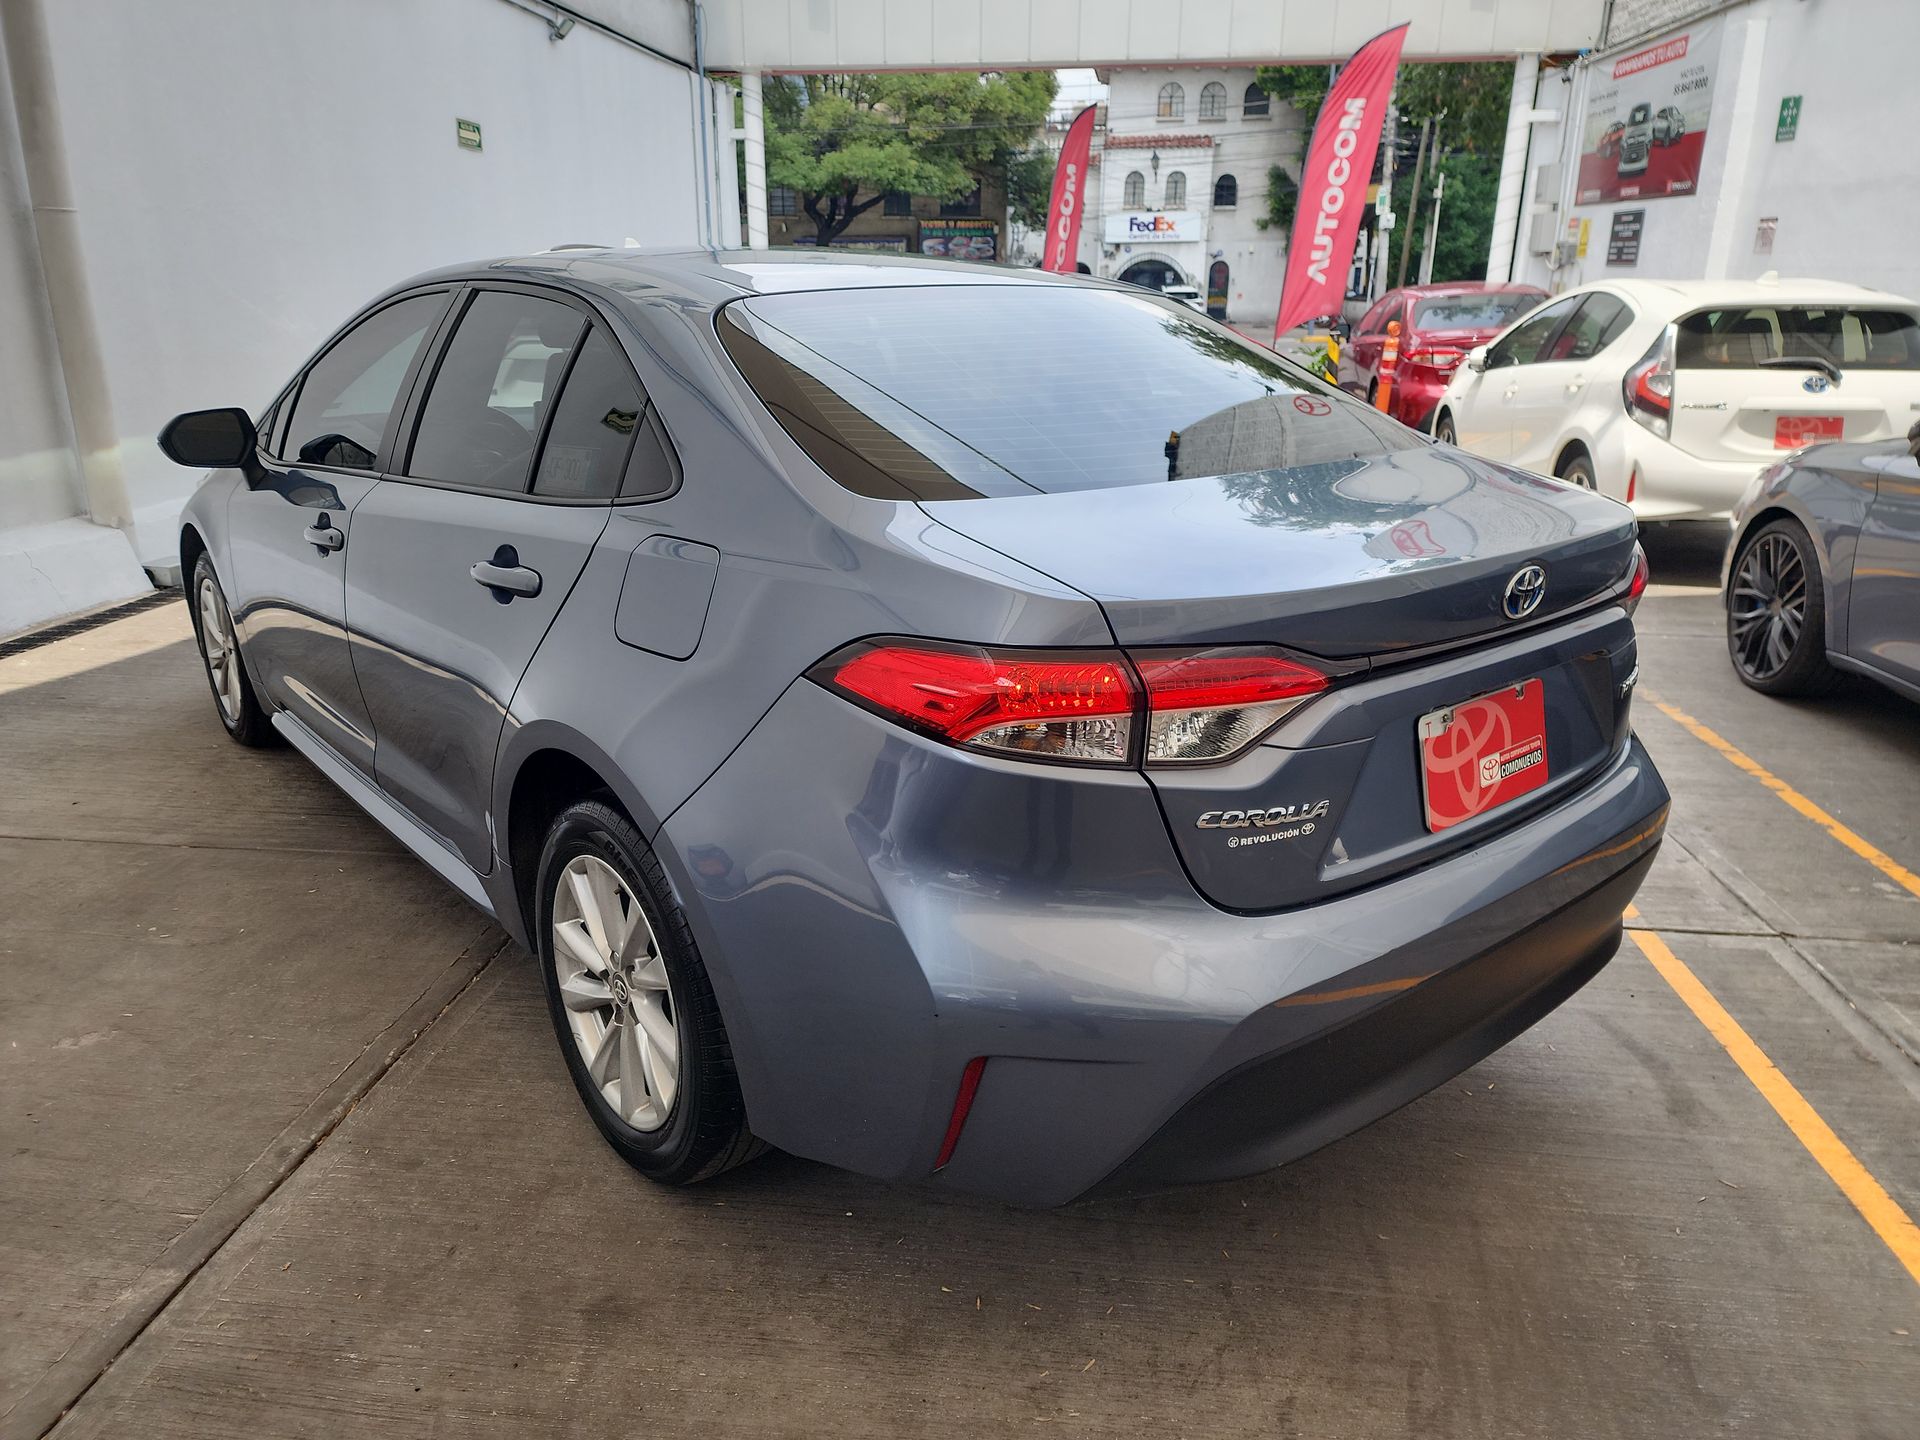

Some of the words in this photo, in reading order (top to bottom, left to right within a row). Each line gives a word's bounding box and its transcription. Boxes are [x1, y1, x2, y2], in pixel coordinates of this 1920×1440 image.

[1307, 97, 1367, 285] AUTOCOM
[1054, 163, 1077, 271] OCOM
[1129, 216, 1175, 232] FedEx
[1501, 750, 1542, 777] COMONUEVOS
[1195, 800, 1330, 829] COROLLA
[1240, 828, 1299, 846] REVOLUCIÓN
